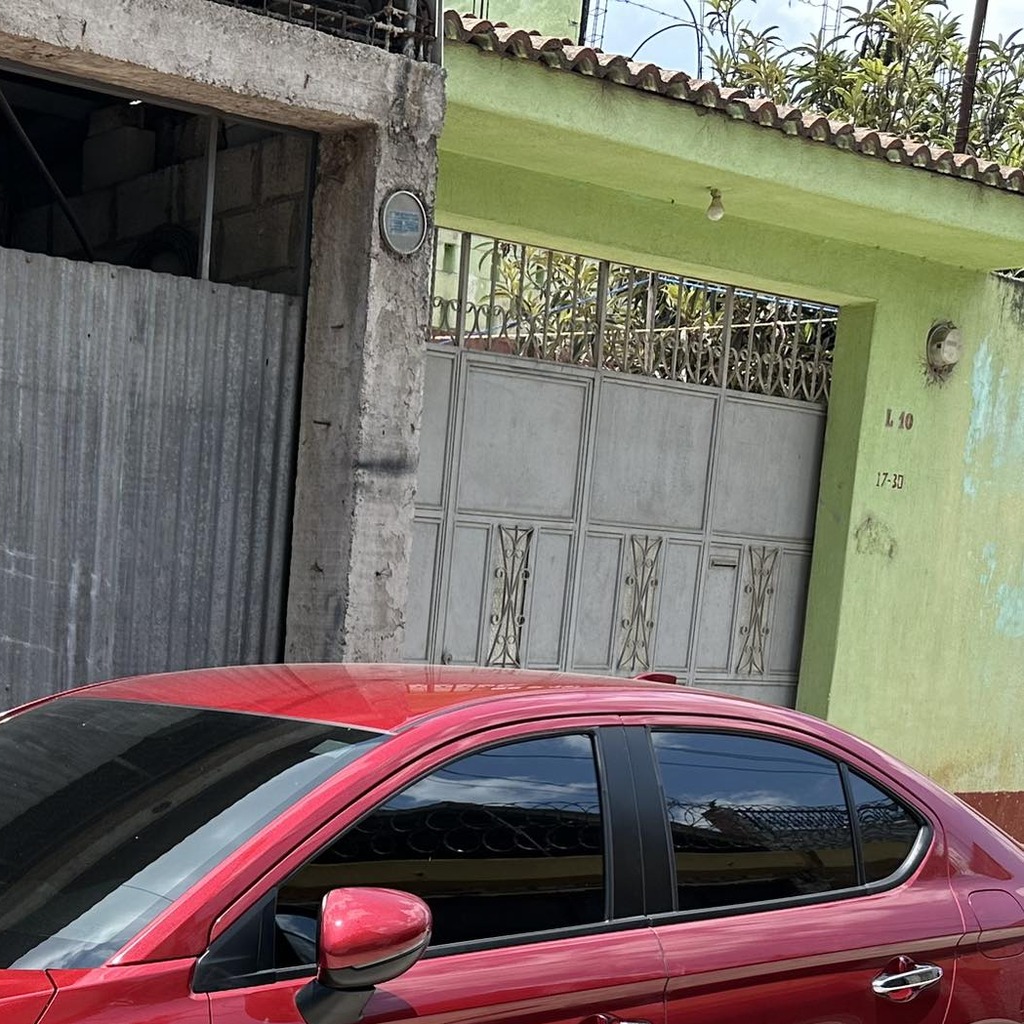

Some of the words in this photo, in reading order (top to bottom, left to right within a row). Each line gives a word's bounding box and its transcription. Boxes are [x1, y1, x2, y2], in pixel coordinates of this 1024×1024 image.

[885, 408, 893, 427] L
[898, 411, 914, 430] 10
[876, 472, 903, 489] 17-30
